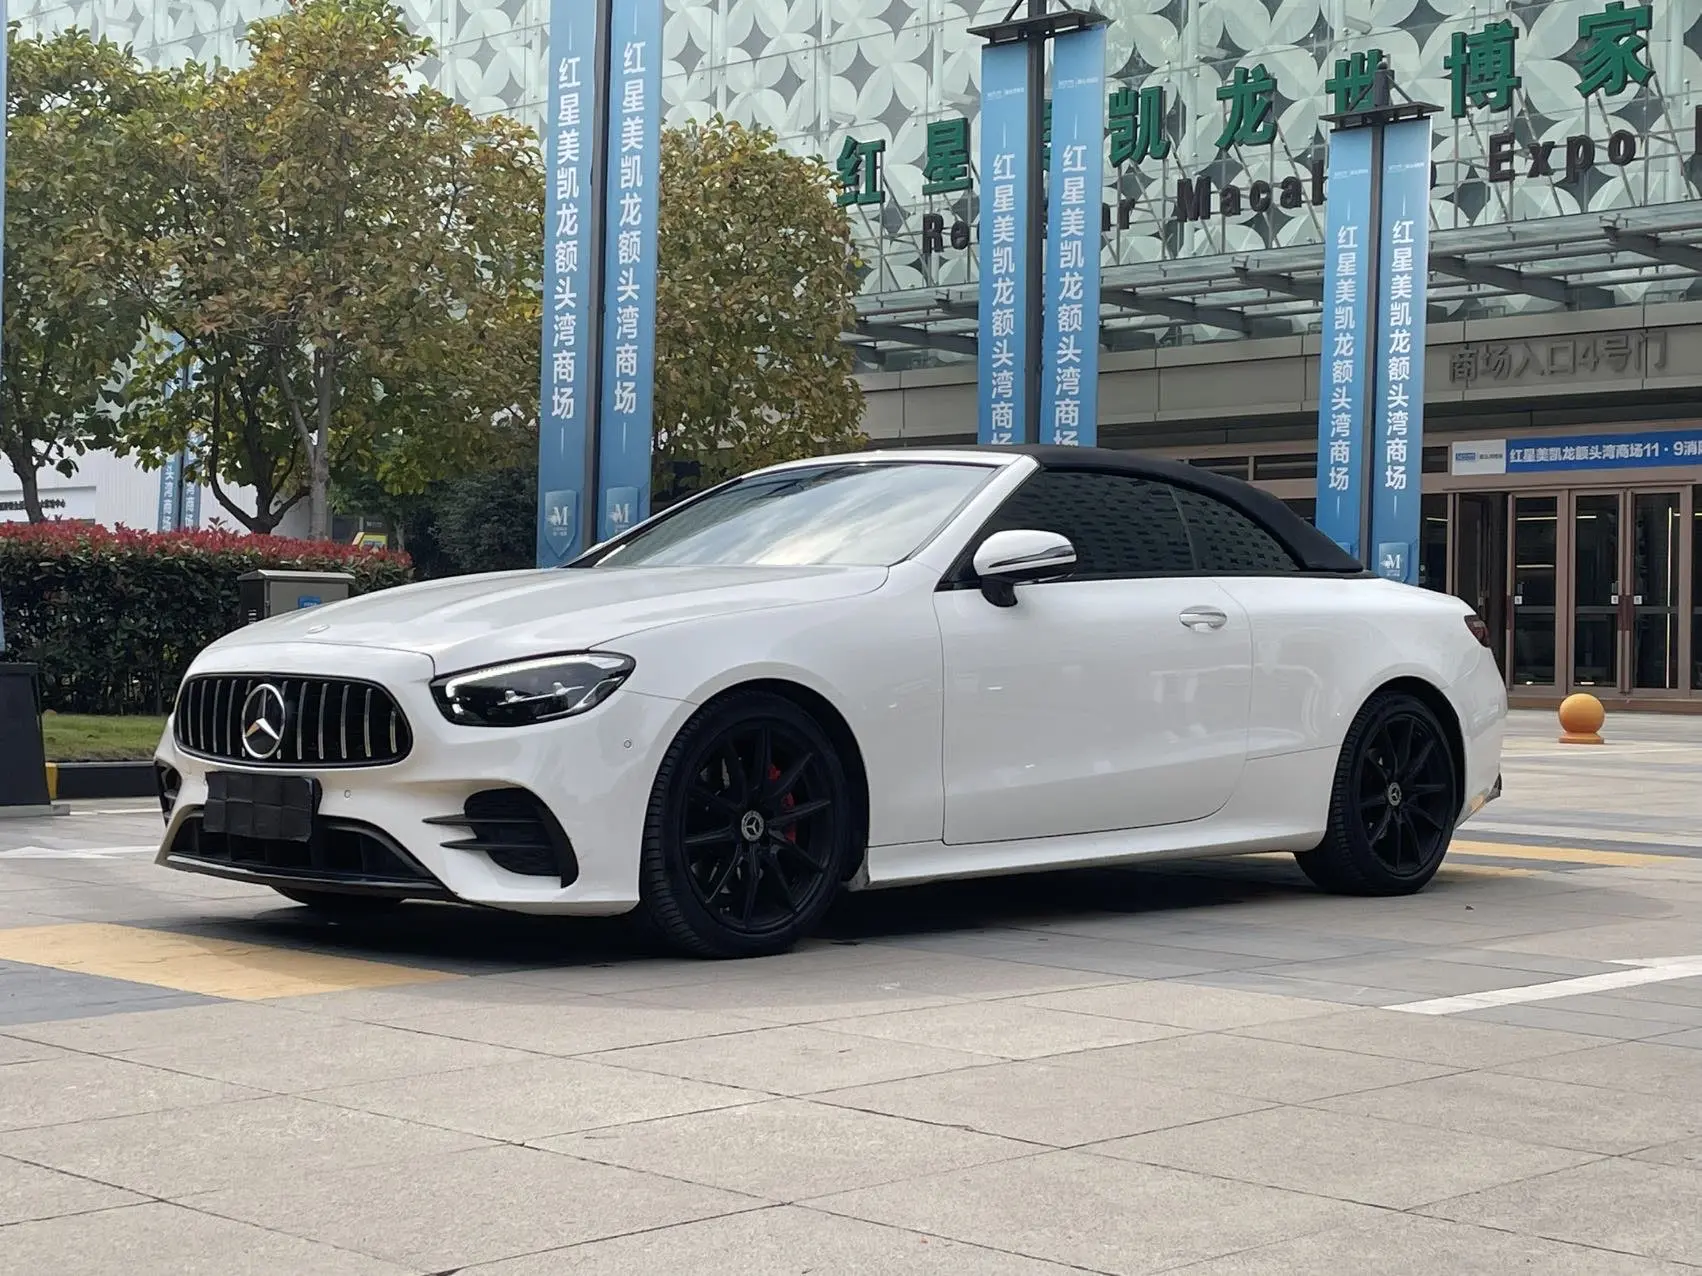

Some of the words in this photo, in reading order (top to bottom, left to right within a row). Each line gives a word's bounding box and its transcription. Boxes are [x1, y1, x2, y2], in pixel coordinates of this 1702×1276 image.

[613, 41, 646, 414] 红星美凯龙额头湾商场
[836, 1, 1654, 206] 红星凯龙世博家
[922, 213, 981, 254] Re
[1488, 128, 1636, 183] Expo
[551, 57, 581, 420] 红星美凯龙额头湾商场
[1328, 225, 1358, 491] 红星美凯龙额头湾商场
[1384, 220, 1414, 490] 红星美凯龙额头湾商场
[1452, 331, 1668, 384] 商场入口4号门
